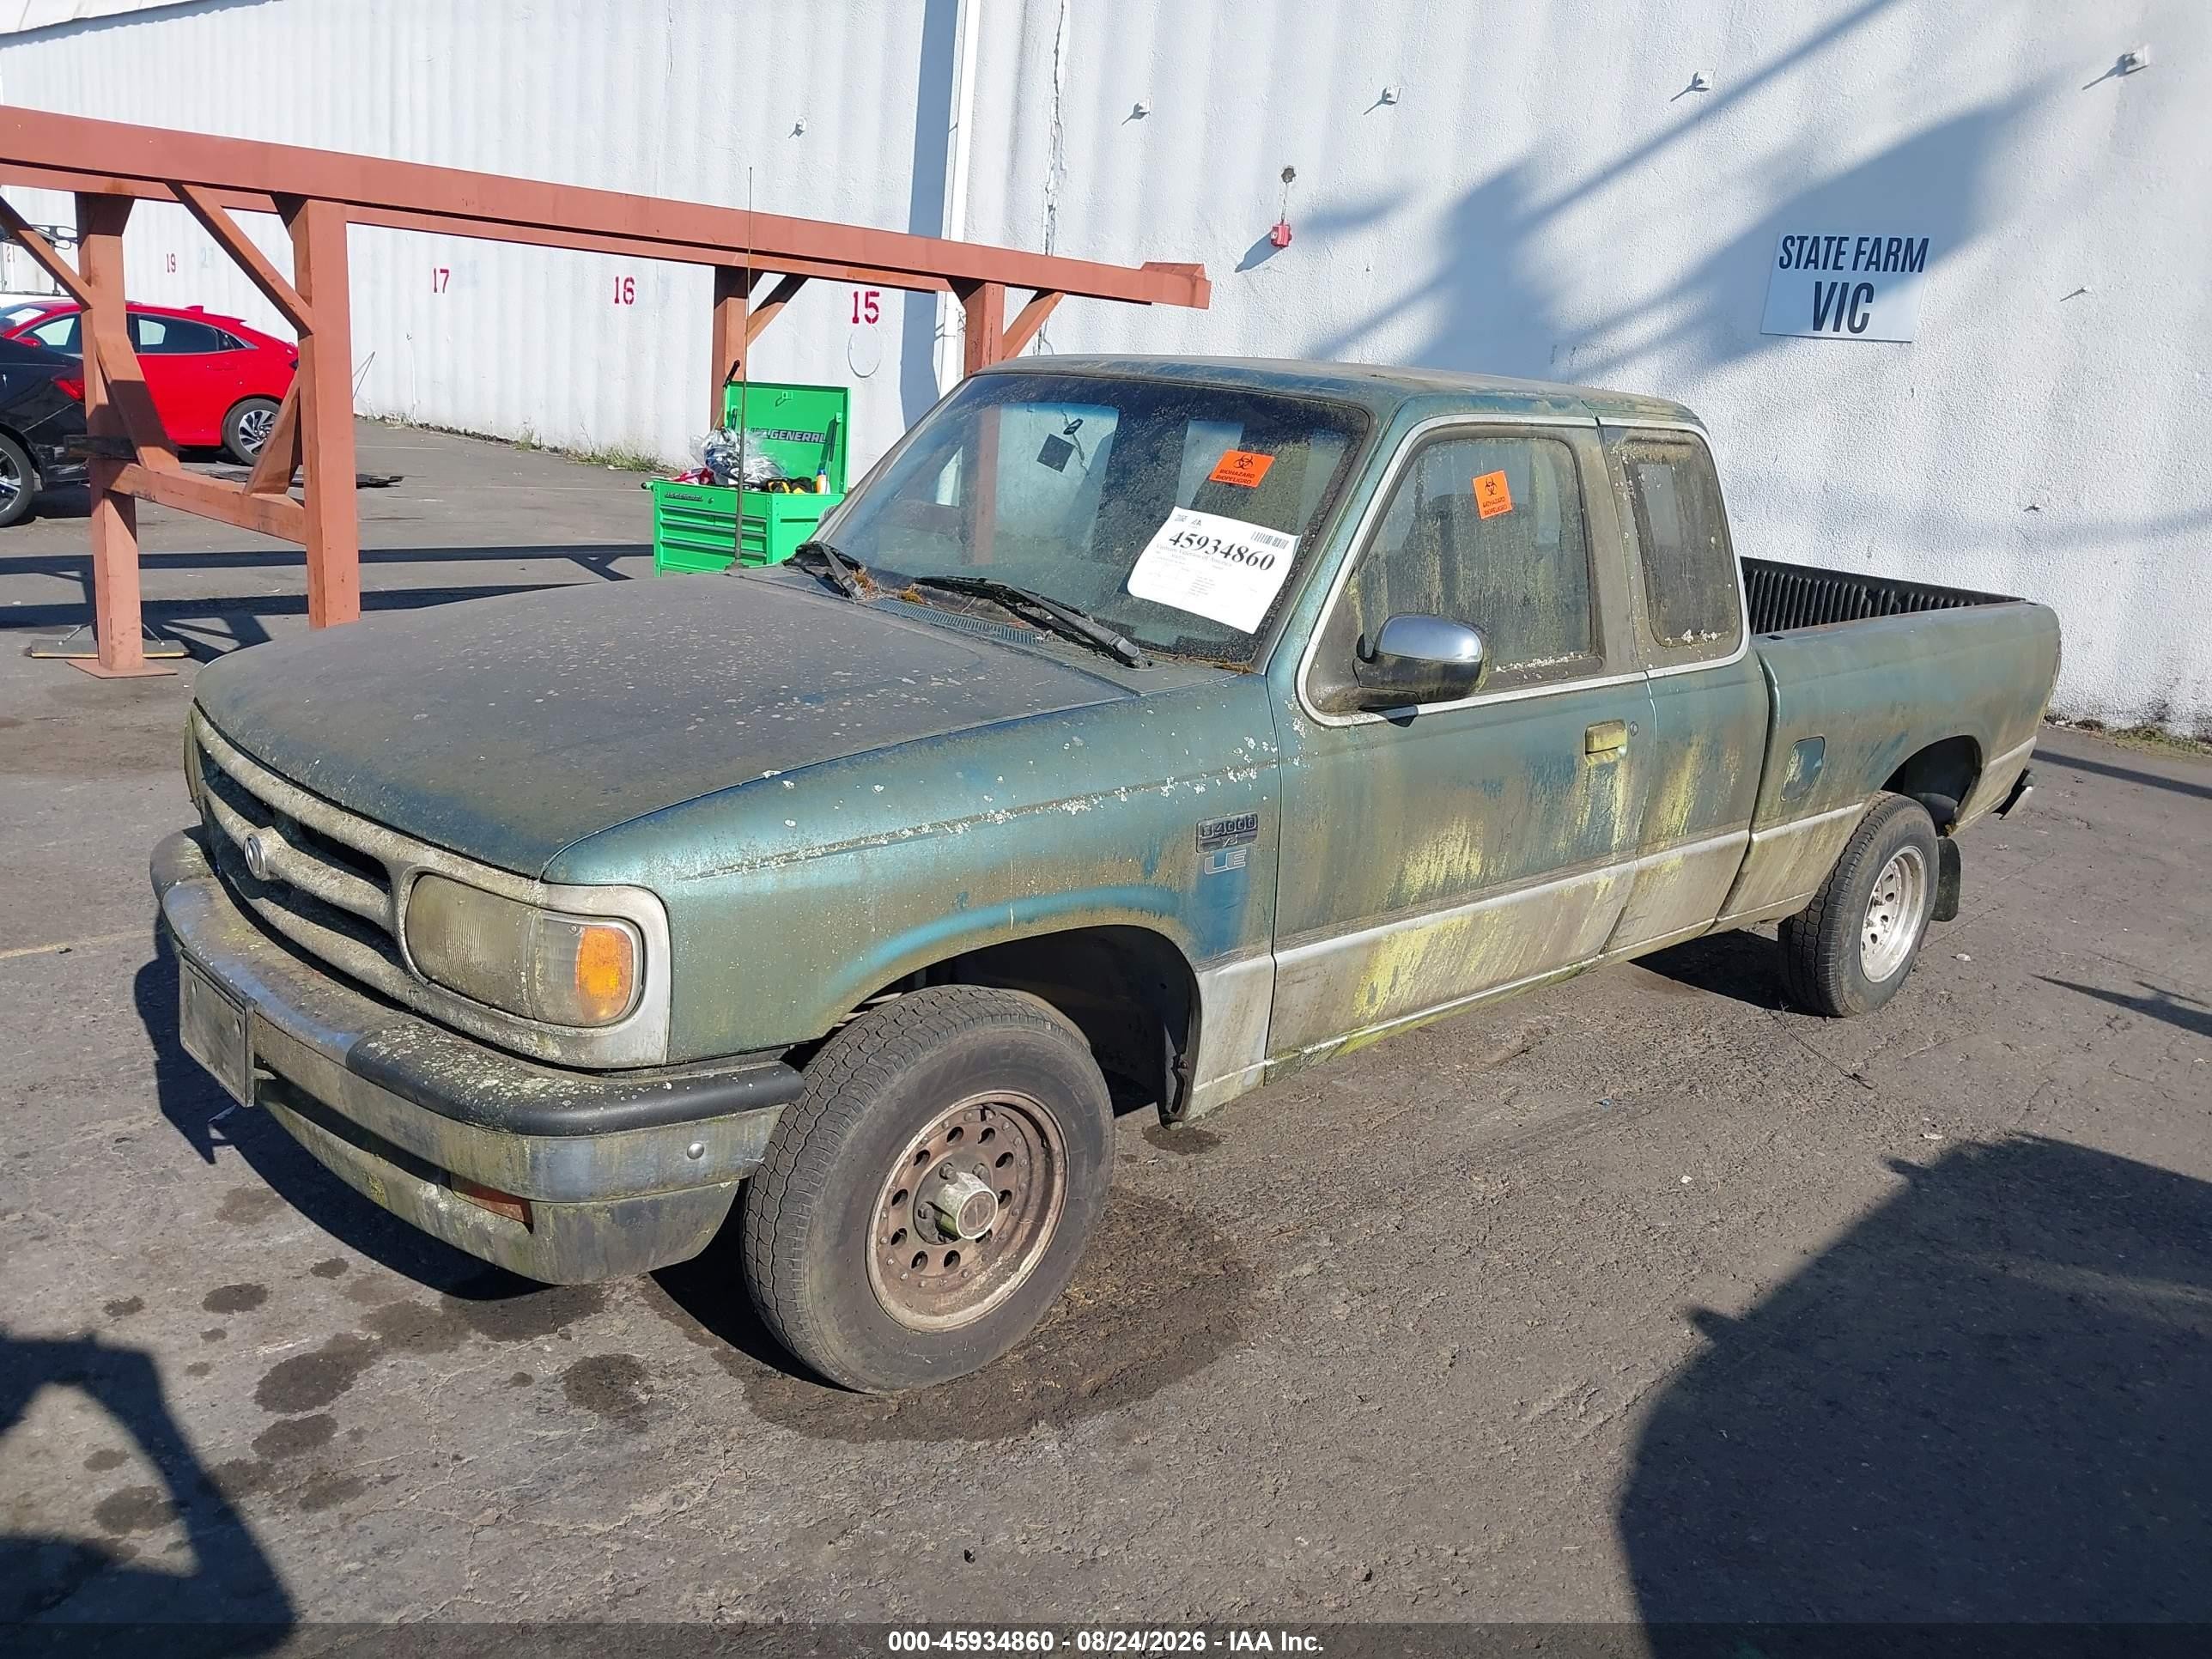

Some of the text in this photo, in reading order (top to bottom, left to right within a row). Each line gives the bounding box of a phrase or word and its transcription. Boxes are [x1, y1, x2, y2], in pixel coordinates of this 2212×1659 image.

[166, 252, 177, 273] 19
[1779, 234, 1929, 273] STATE FARM
[432, 267, 450, 294] 17
[614, 276, 635, 305] 16
[852, 290, 880, 325] 15
[1813, 281, 1875, 334] VIC
[1219, 468, 1255, 479] BIOHAZARD
[1169, 531, 1276, 571] 45934860
[1204, 849, 1247, 875] LE
